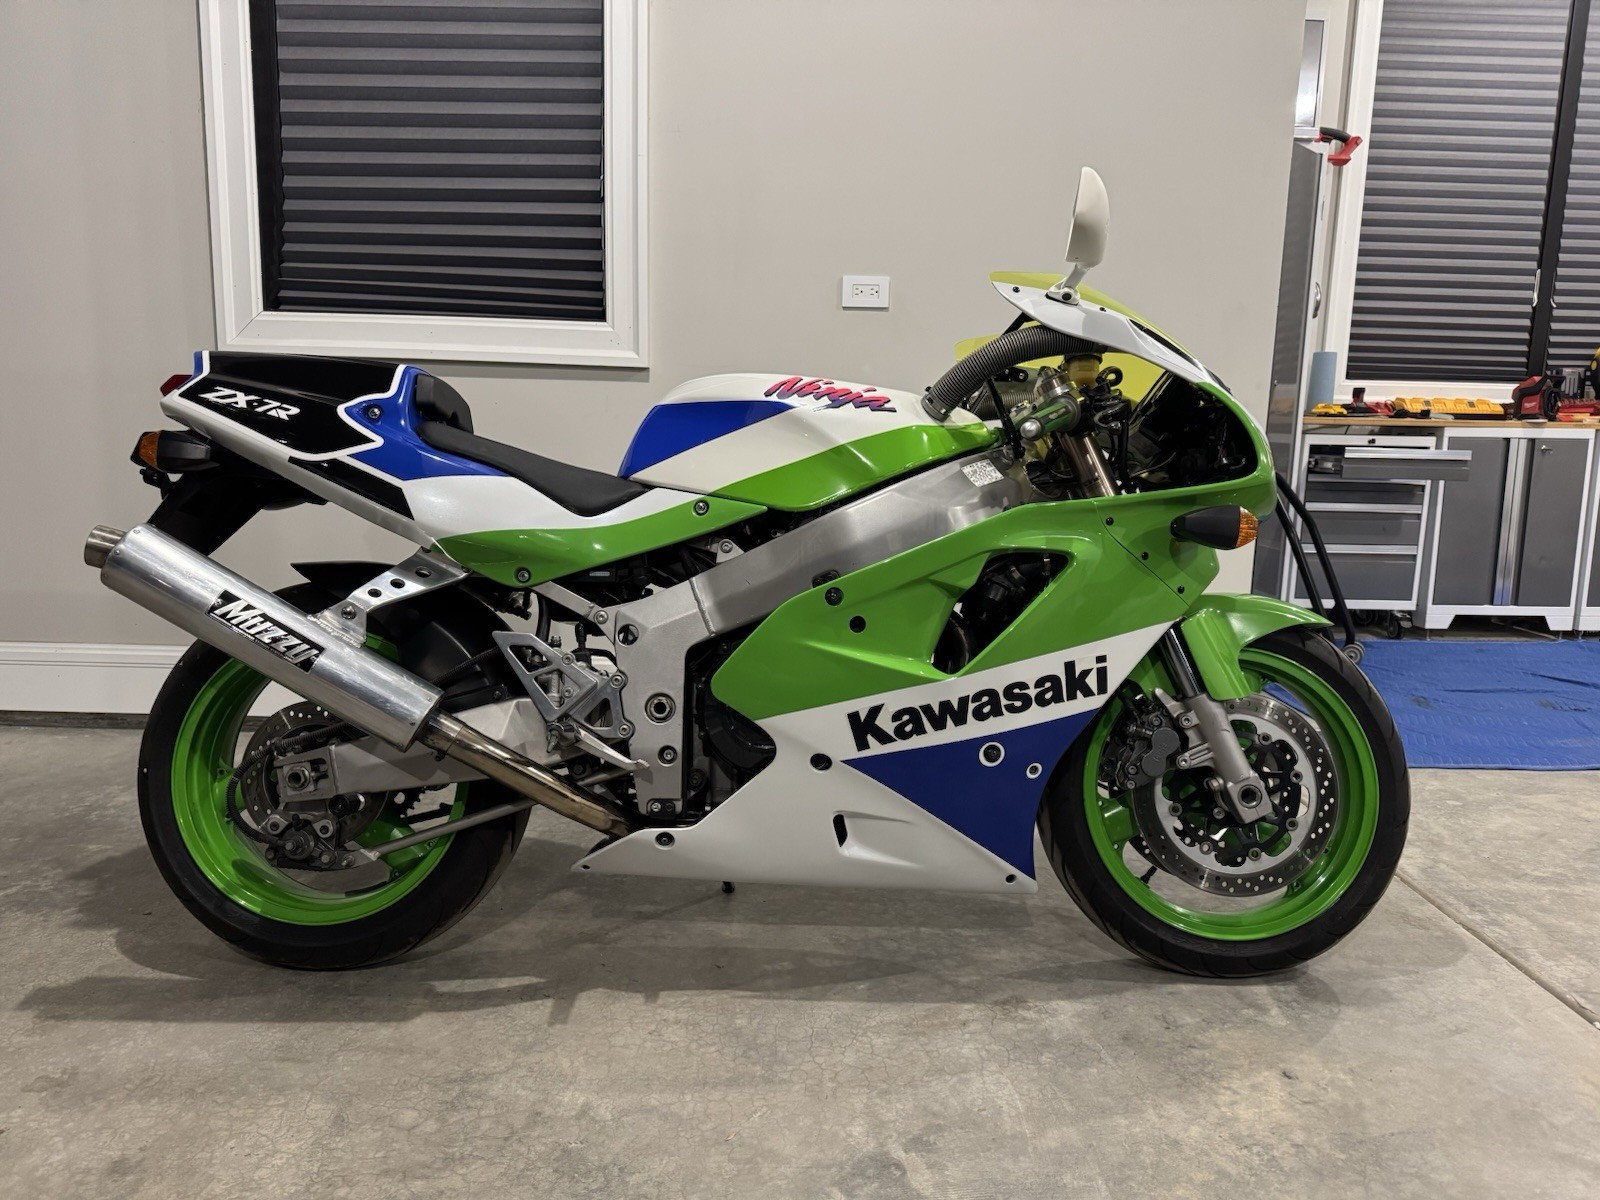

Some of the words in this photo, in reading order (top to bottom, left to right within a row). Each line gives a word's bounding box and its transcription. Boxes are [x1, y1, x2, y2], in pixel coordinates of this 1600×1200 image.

[198, 386, 301, 420] ZX-7R
[764, 376, 897, 412] Ninja
[847, 654, 1109, 752] Kawasaki
